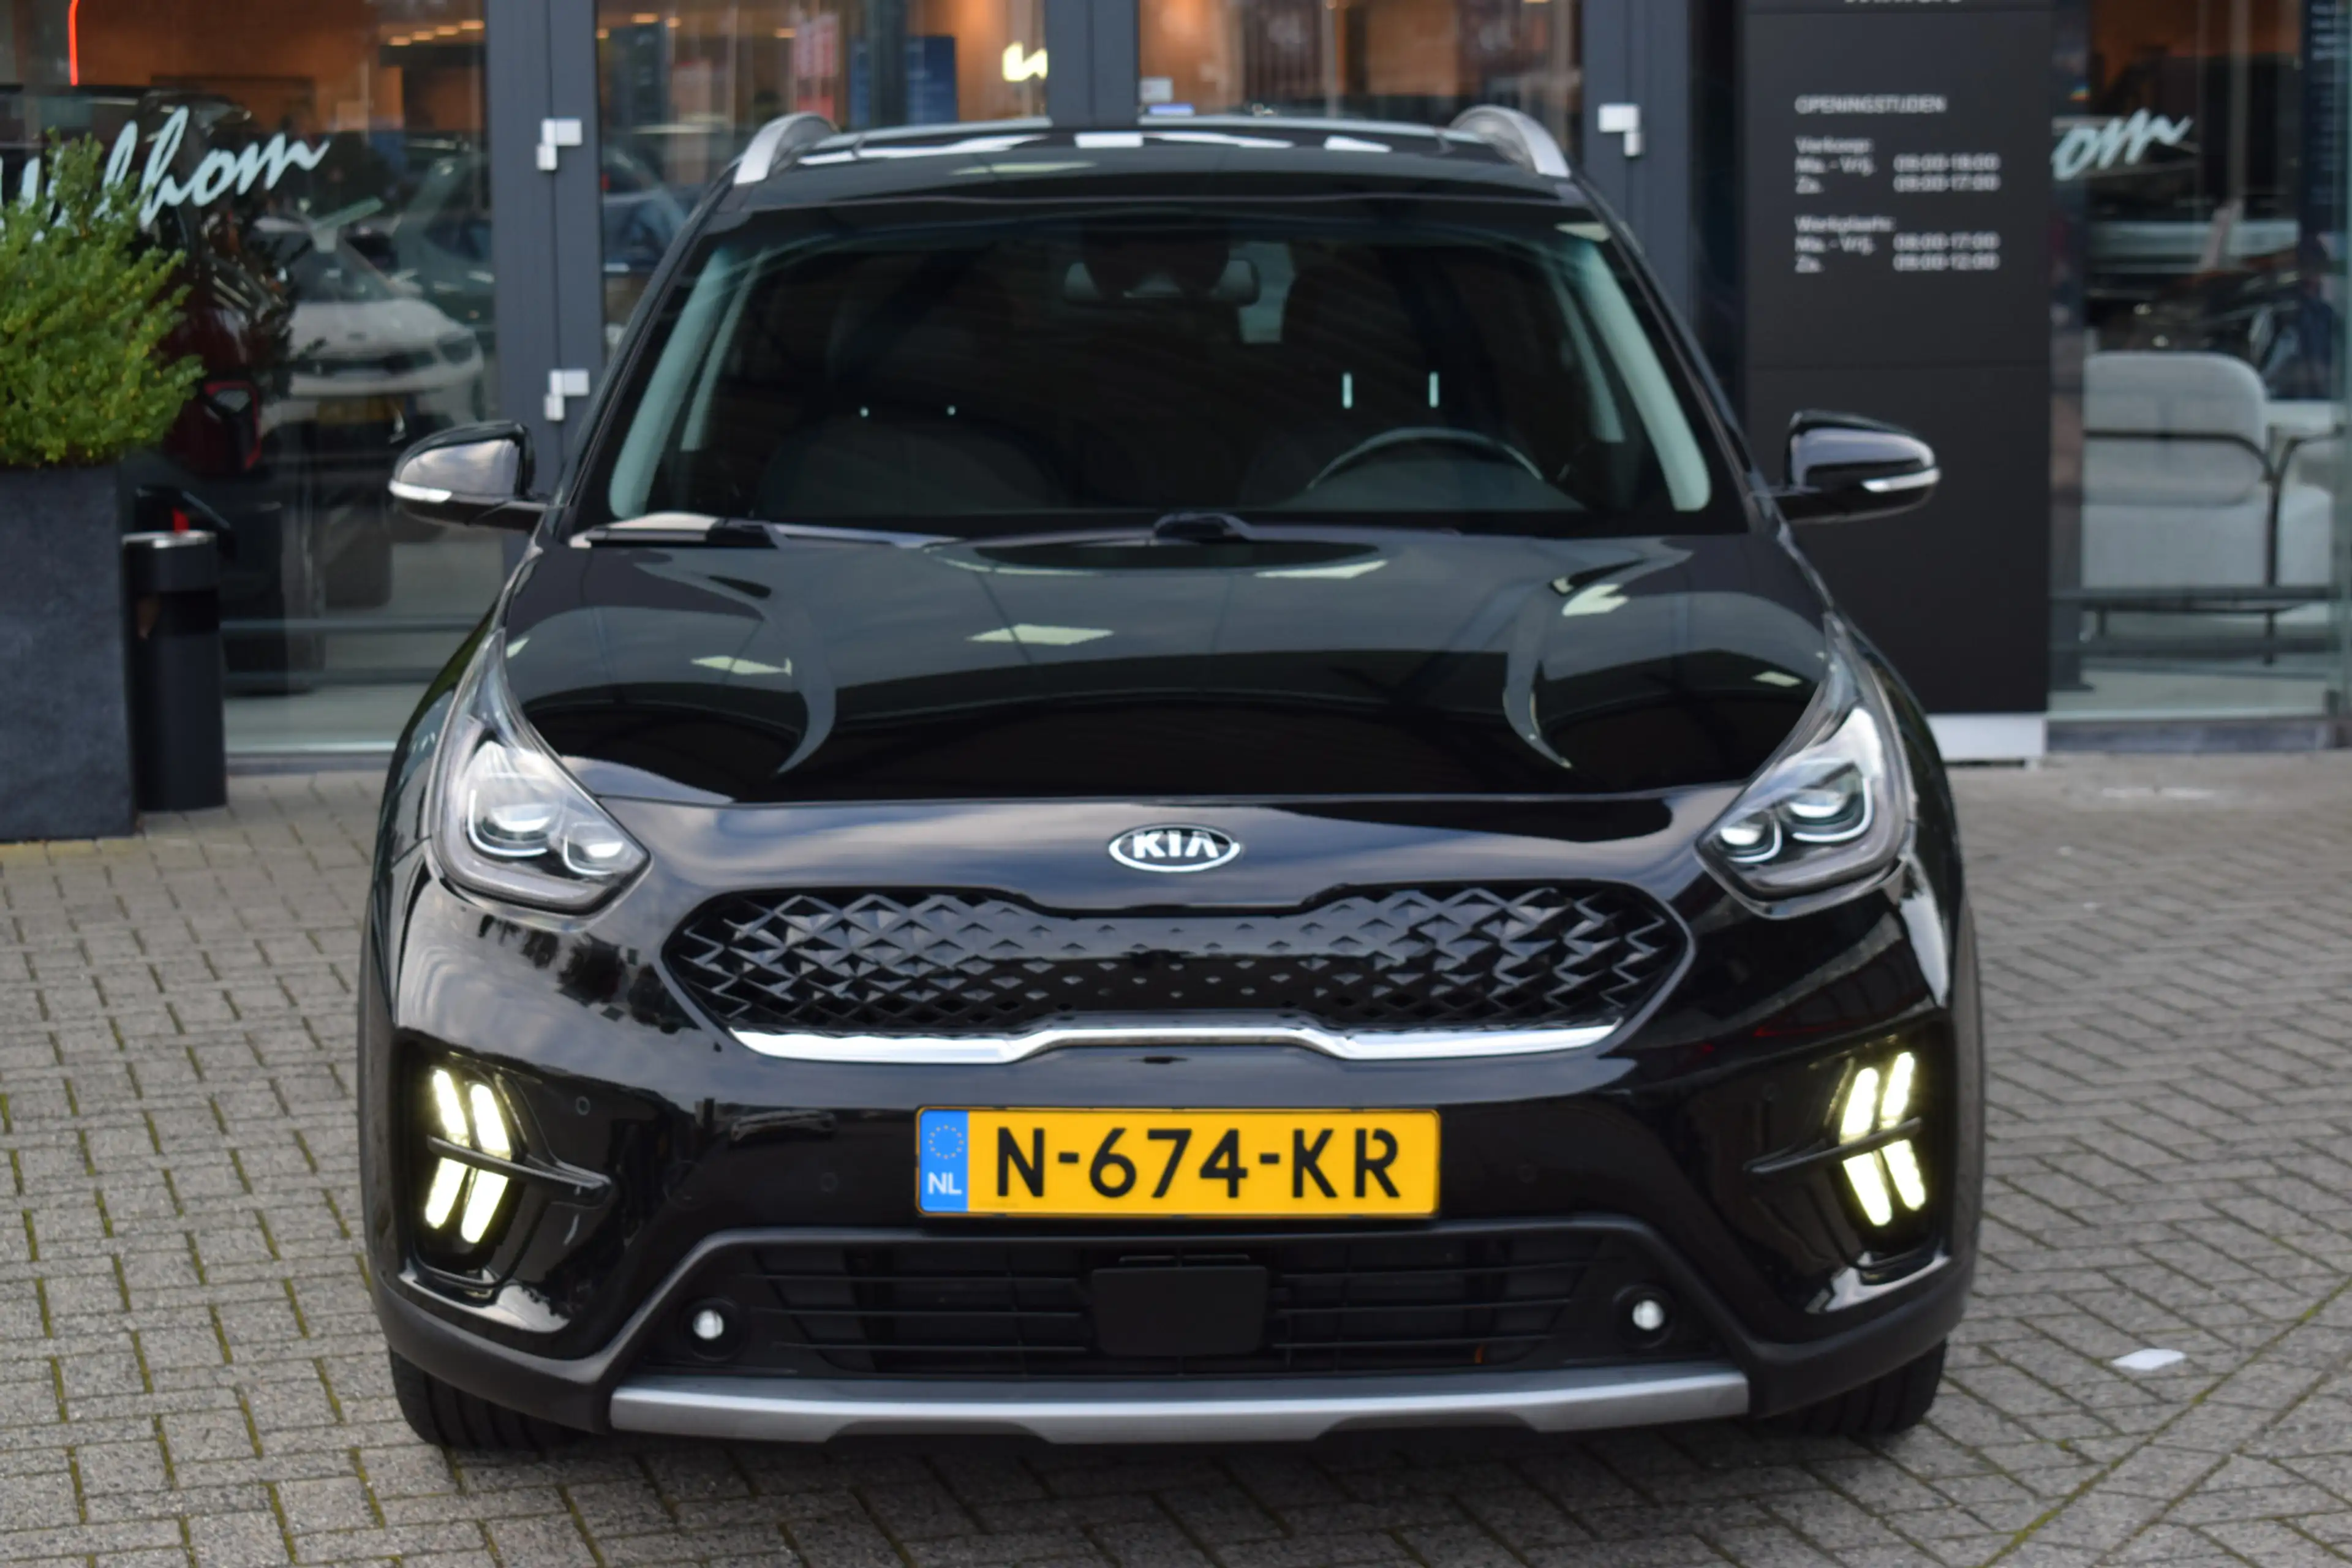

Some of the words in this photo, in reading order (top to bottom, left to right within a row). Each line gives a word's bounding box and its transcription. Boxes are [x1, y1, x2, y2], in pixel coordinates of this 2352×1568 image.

[1133, 830, 1219, 859] KIA
[997, 1126, 1401, 1199] N-674-KR
[927, 1171, 962, 1195] NL
